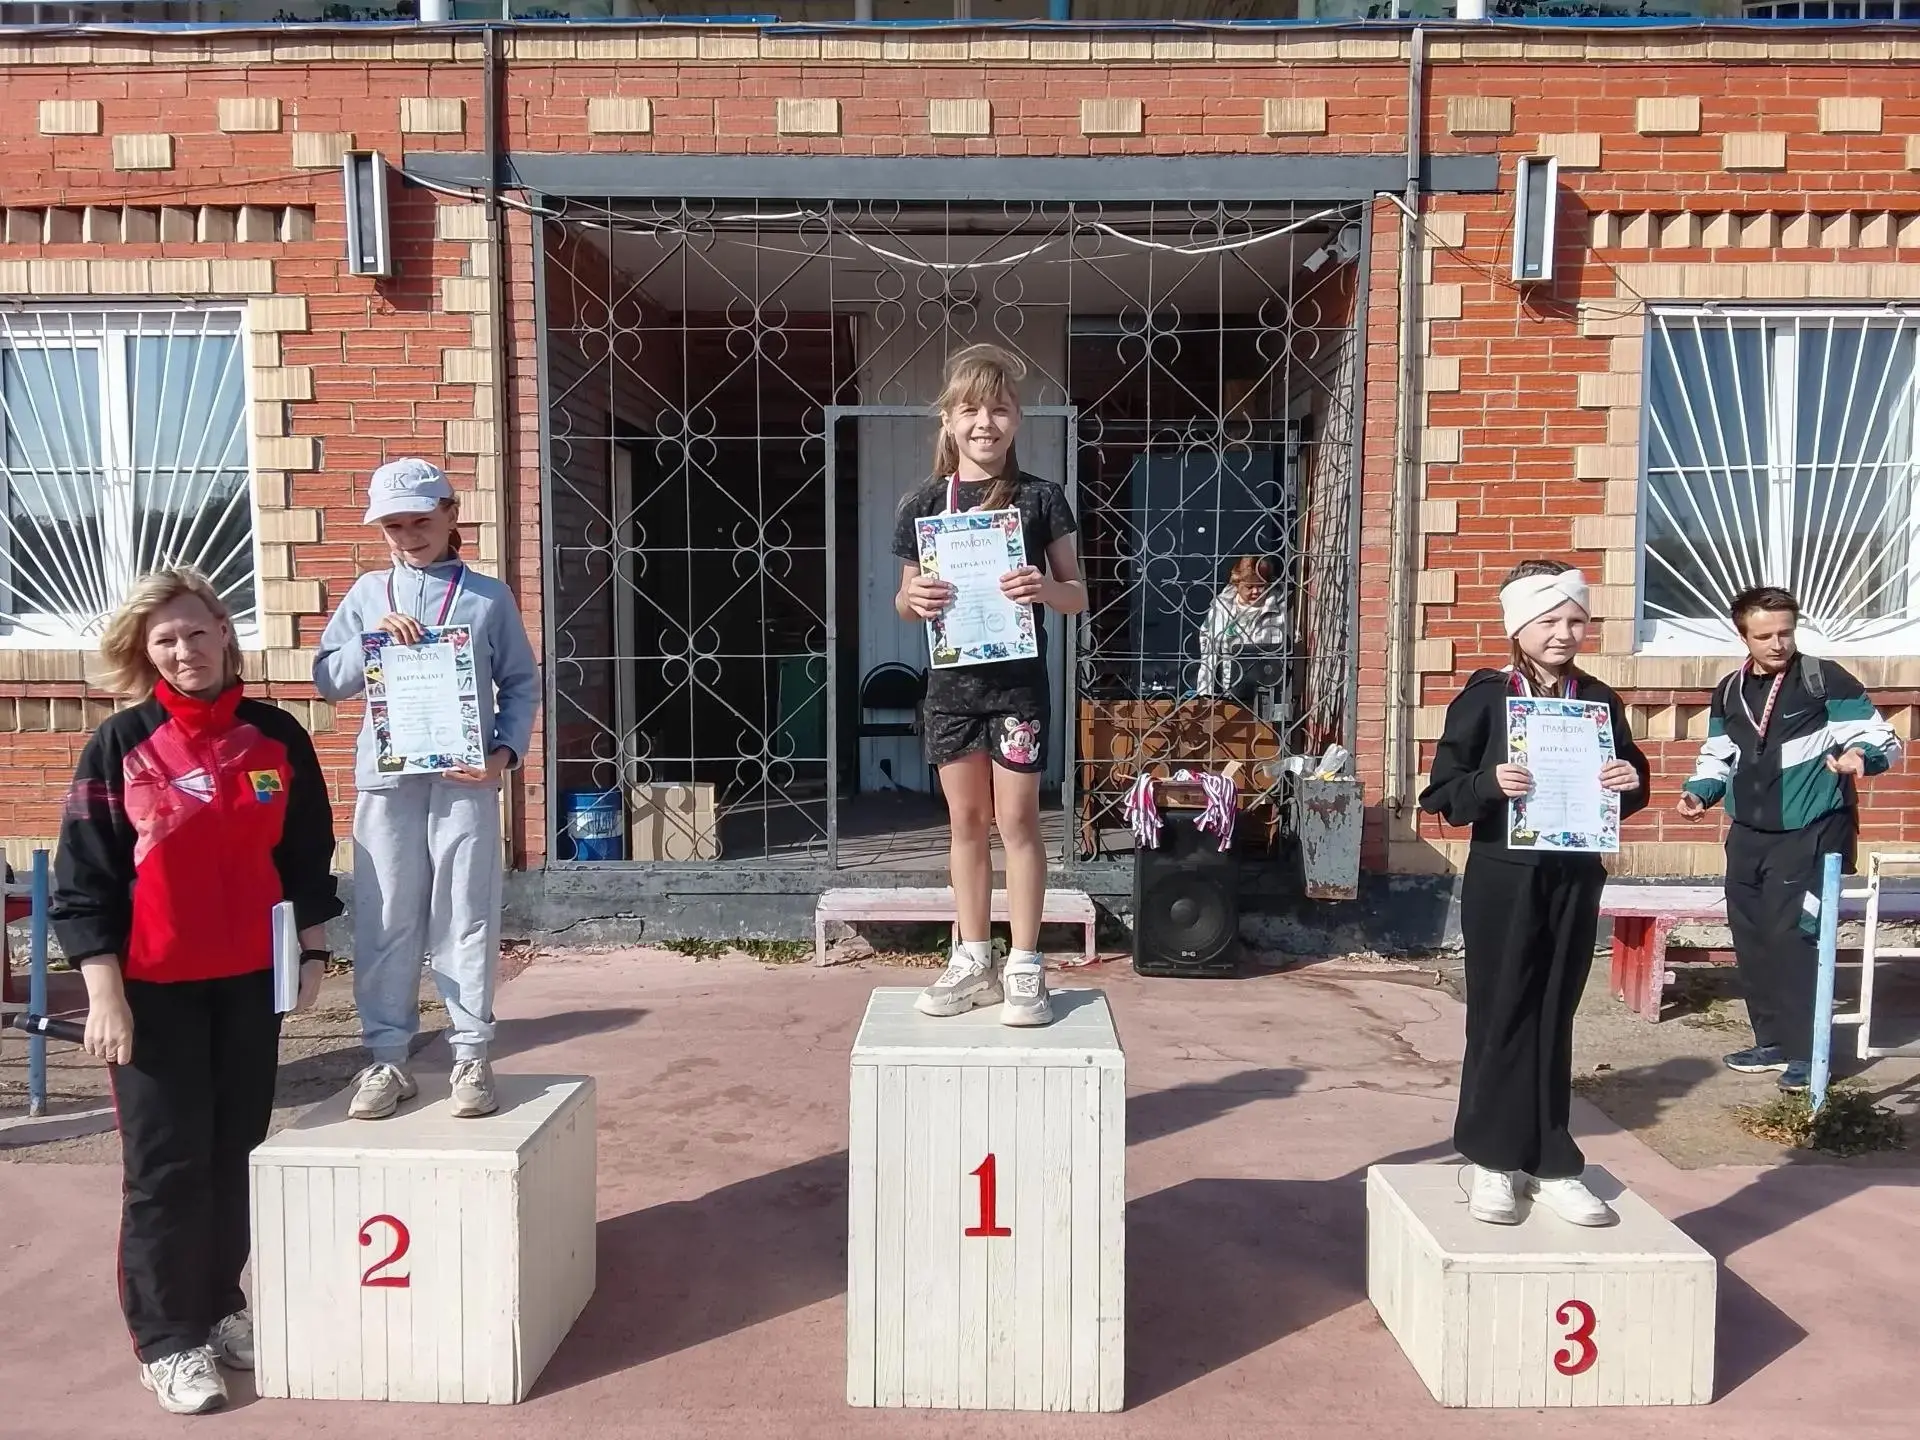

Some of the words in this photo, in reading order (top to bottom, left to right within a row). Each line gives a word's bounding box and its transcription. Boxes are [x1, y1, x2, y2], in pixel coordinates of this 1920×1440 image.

[951, 539, 992, 550] ГРАМОТА
[397, 652, 440, 663] ГРАМОТА
[1542, 724, 1585, 734] ГРАМОТА
[965, 1153, 1012, 1237] 1
[359, 1214, 410, 1287] 2
[1554, 1300, 1599, 1376] 3
